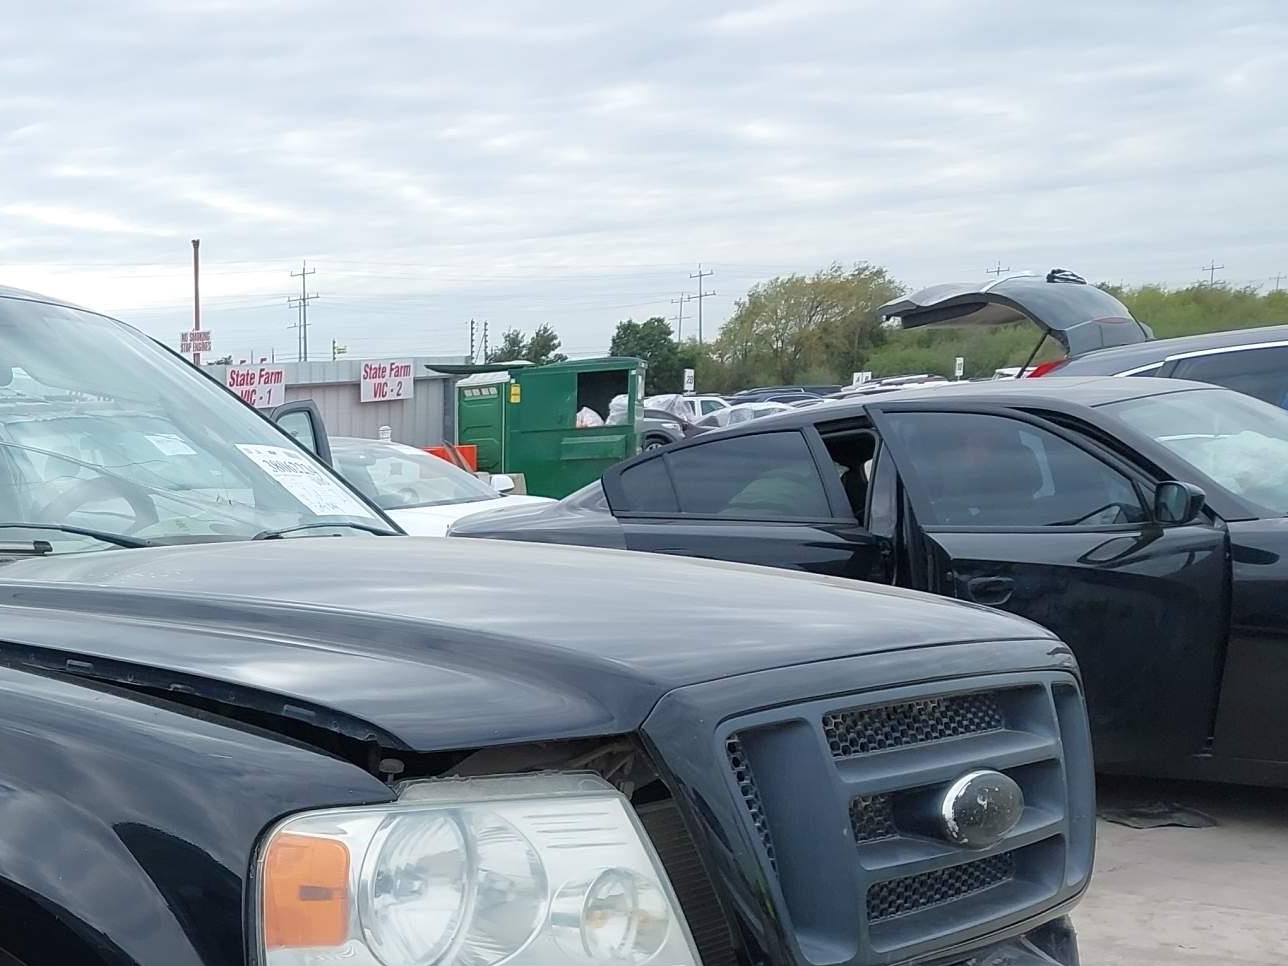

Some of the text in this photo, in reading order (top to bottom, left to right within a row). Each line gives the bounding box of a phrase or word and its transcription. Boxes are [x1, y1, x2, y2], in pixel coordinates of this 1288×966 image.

[190, 331, 210, 341] SMOKING
[180, 342, 191, 352] STOP
[229, 368, 283, 388] State Farm
[362, 362, 411, 380] State Farm
[265, 388, 272, 404] 1
[373, 382, 388, 398] VIC
[396, 381, 402, 396] 2
